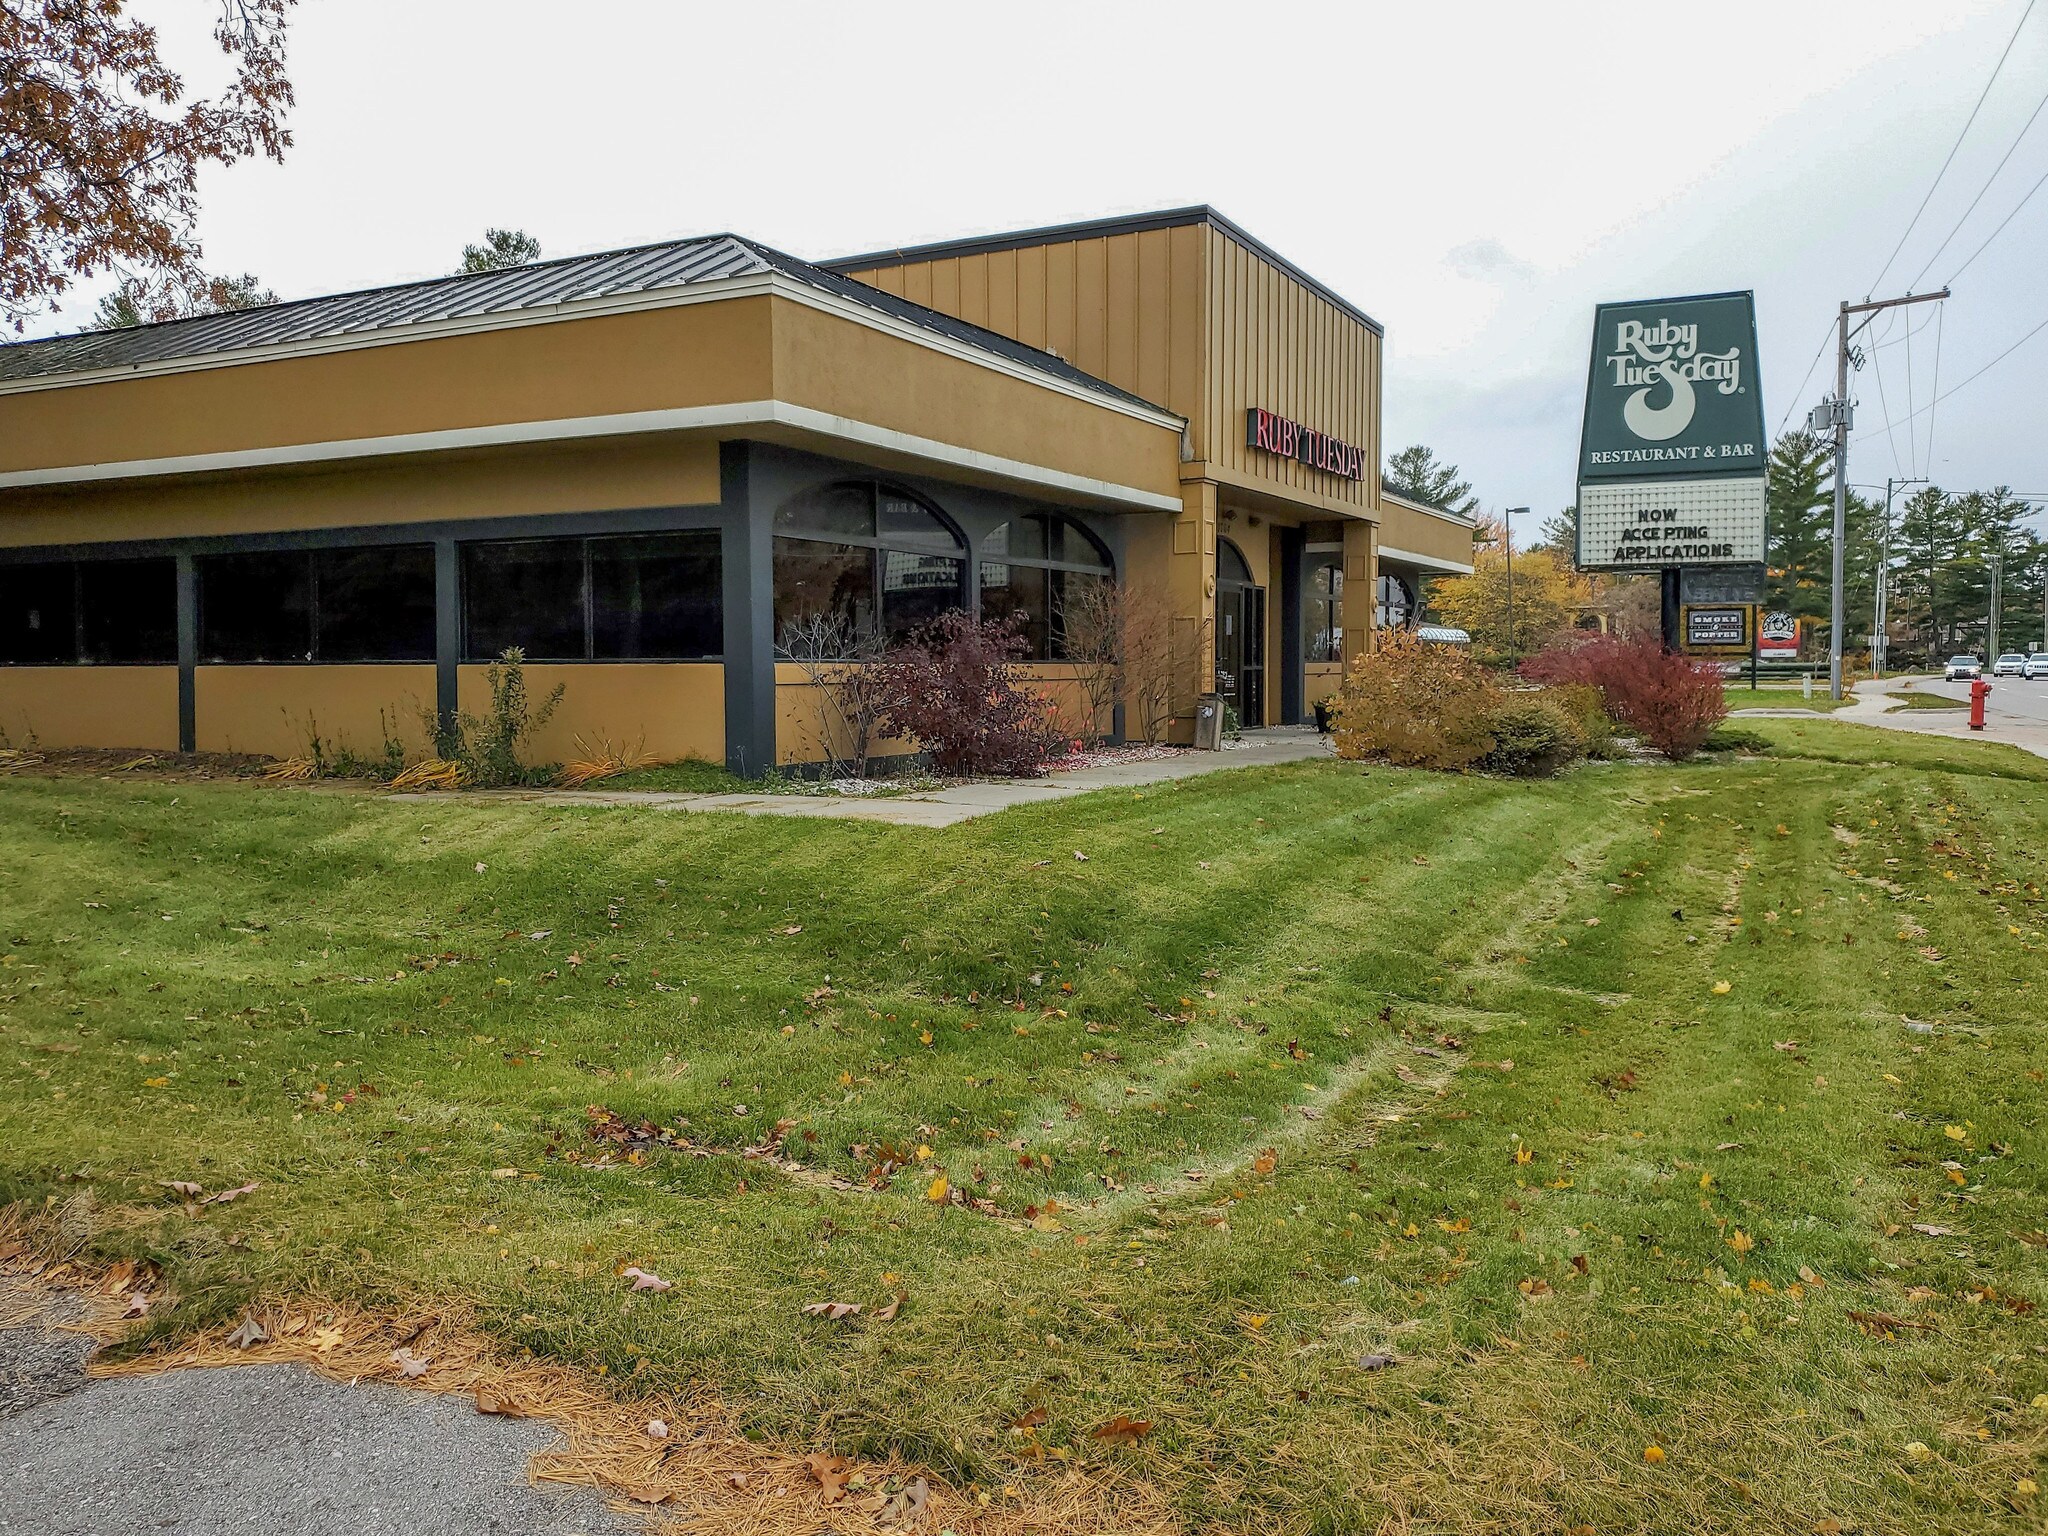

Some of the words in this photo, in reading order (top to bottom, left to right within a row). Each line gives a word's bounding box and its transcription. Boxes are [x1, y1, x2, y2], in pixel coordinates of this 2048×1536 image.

[1615, 318, 1698, 362] Ruby
[1256, 408, 1302, 460] RUBY
[1305, 427, 1367, 481] TUESDAY
[1591, 446, 1700, 464] RESTAURANT
[1703, 446, 1716, 458] &
[1720, 443, 1755, 458] BAR
[1638, 508, 1678, 523] NOW
[1613, 543, 1734, 562] APPLICATIONS
